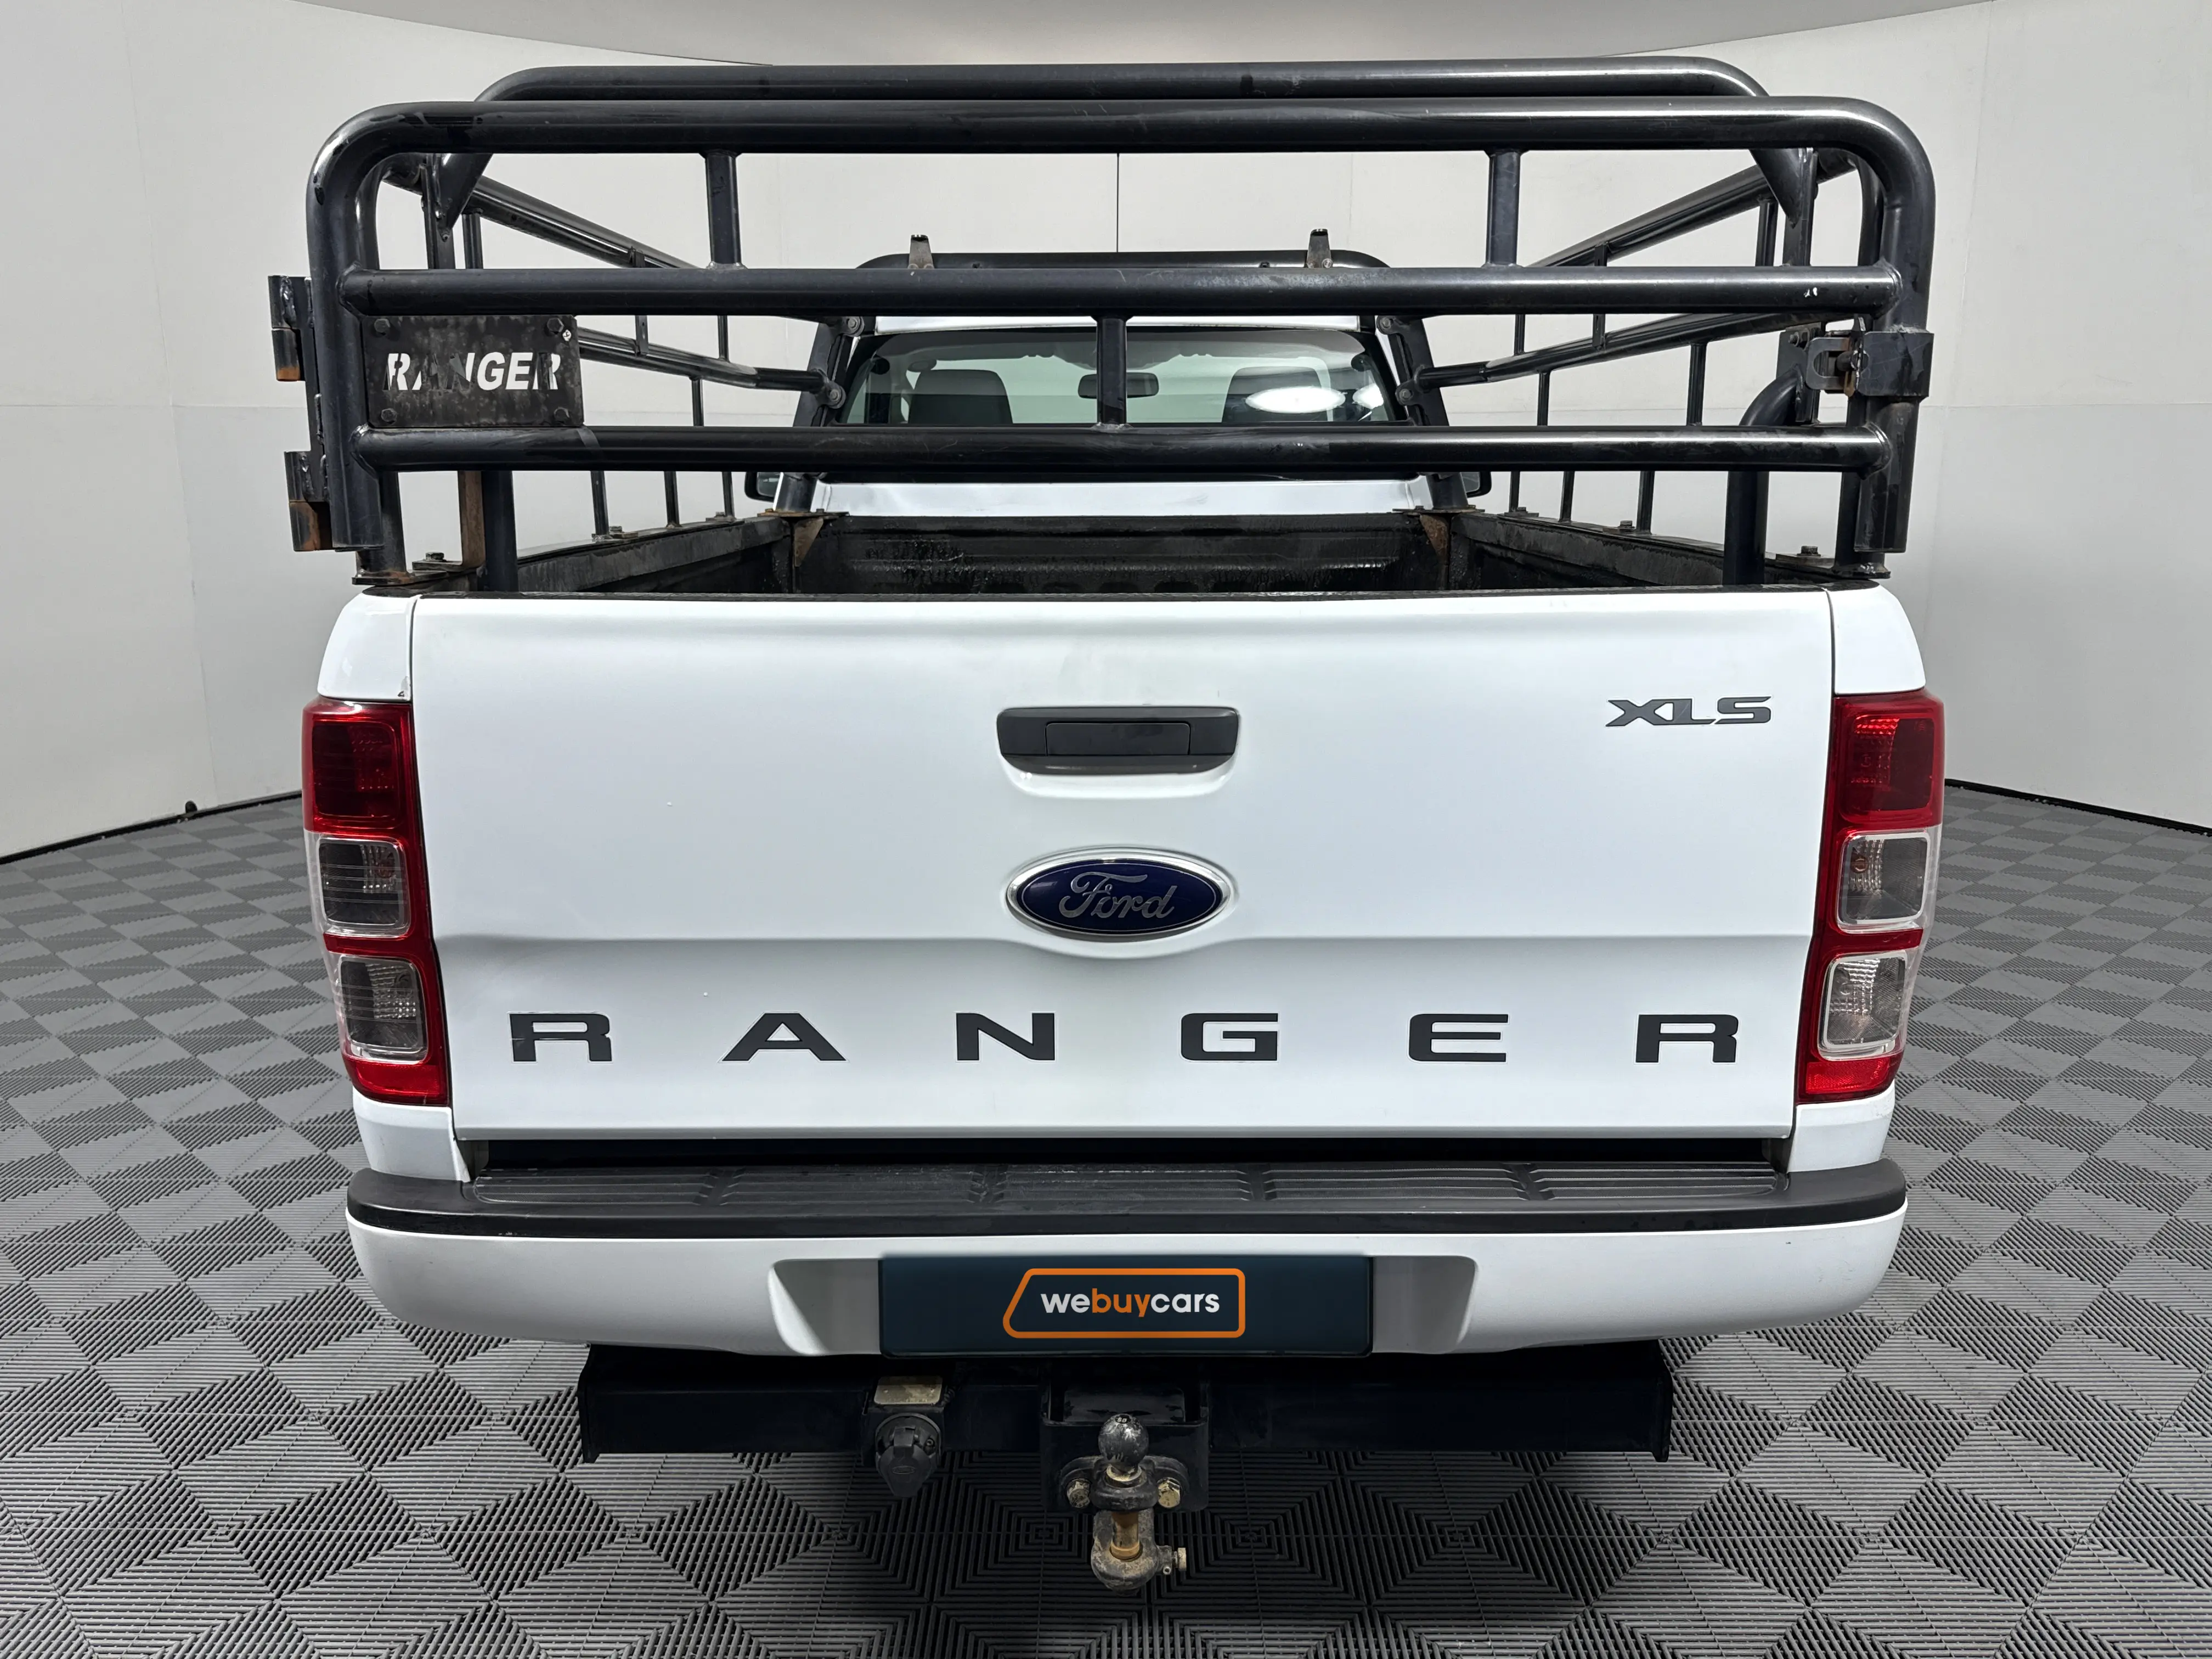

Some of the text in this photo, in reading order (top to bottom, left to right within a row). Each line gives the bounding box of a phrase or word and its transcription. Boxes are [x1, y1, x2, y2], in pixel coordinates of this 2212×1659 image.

[383, 352, 561, 391] RANGER
[1605, 696, 1771, 727] XLS
[1059, 871, 1178, 918] Ford
[510, 1013, 1740, 1064] RANGER
[1041, 1288, 1220, 1317] webuycars
